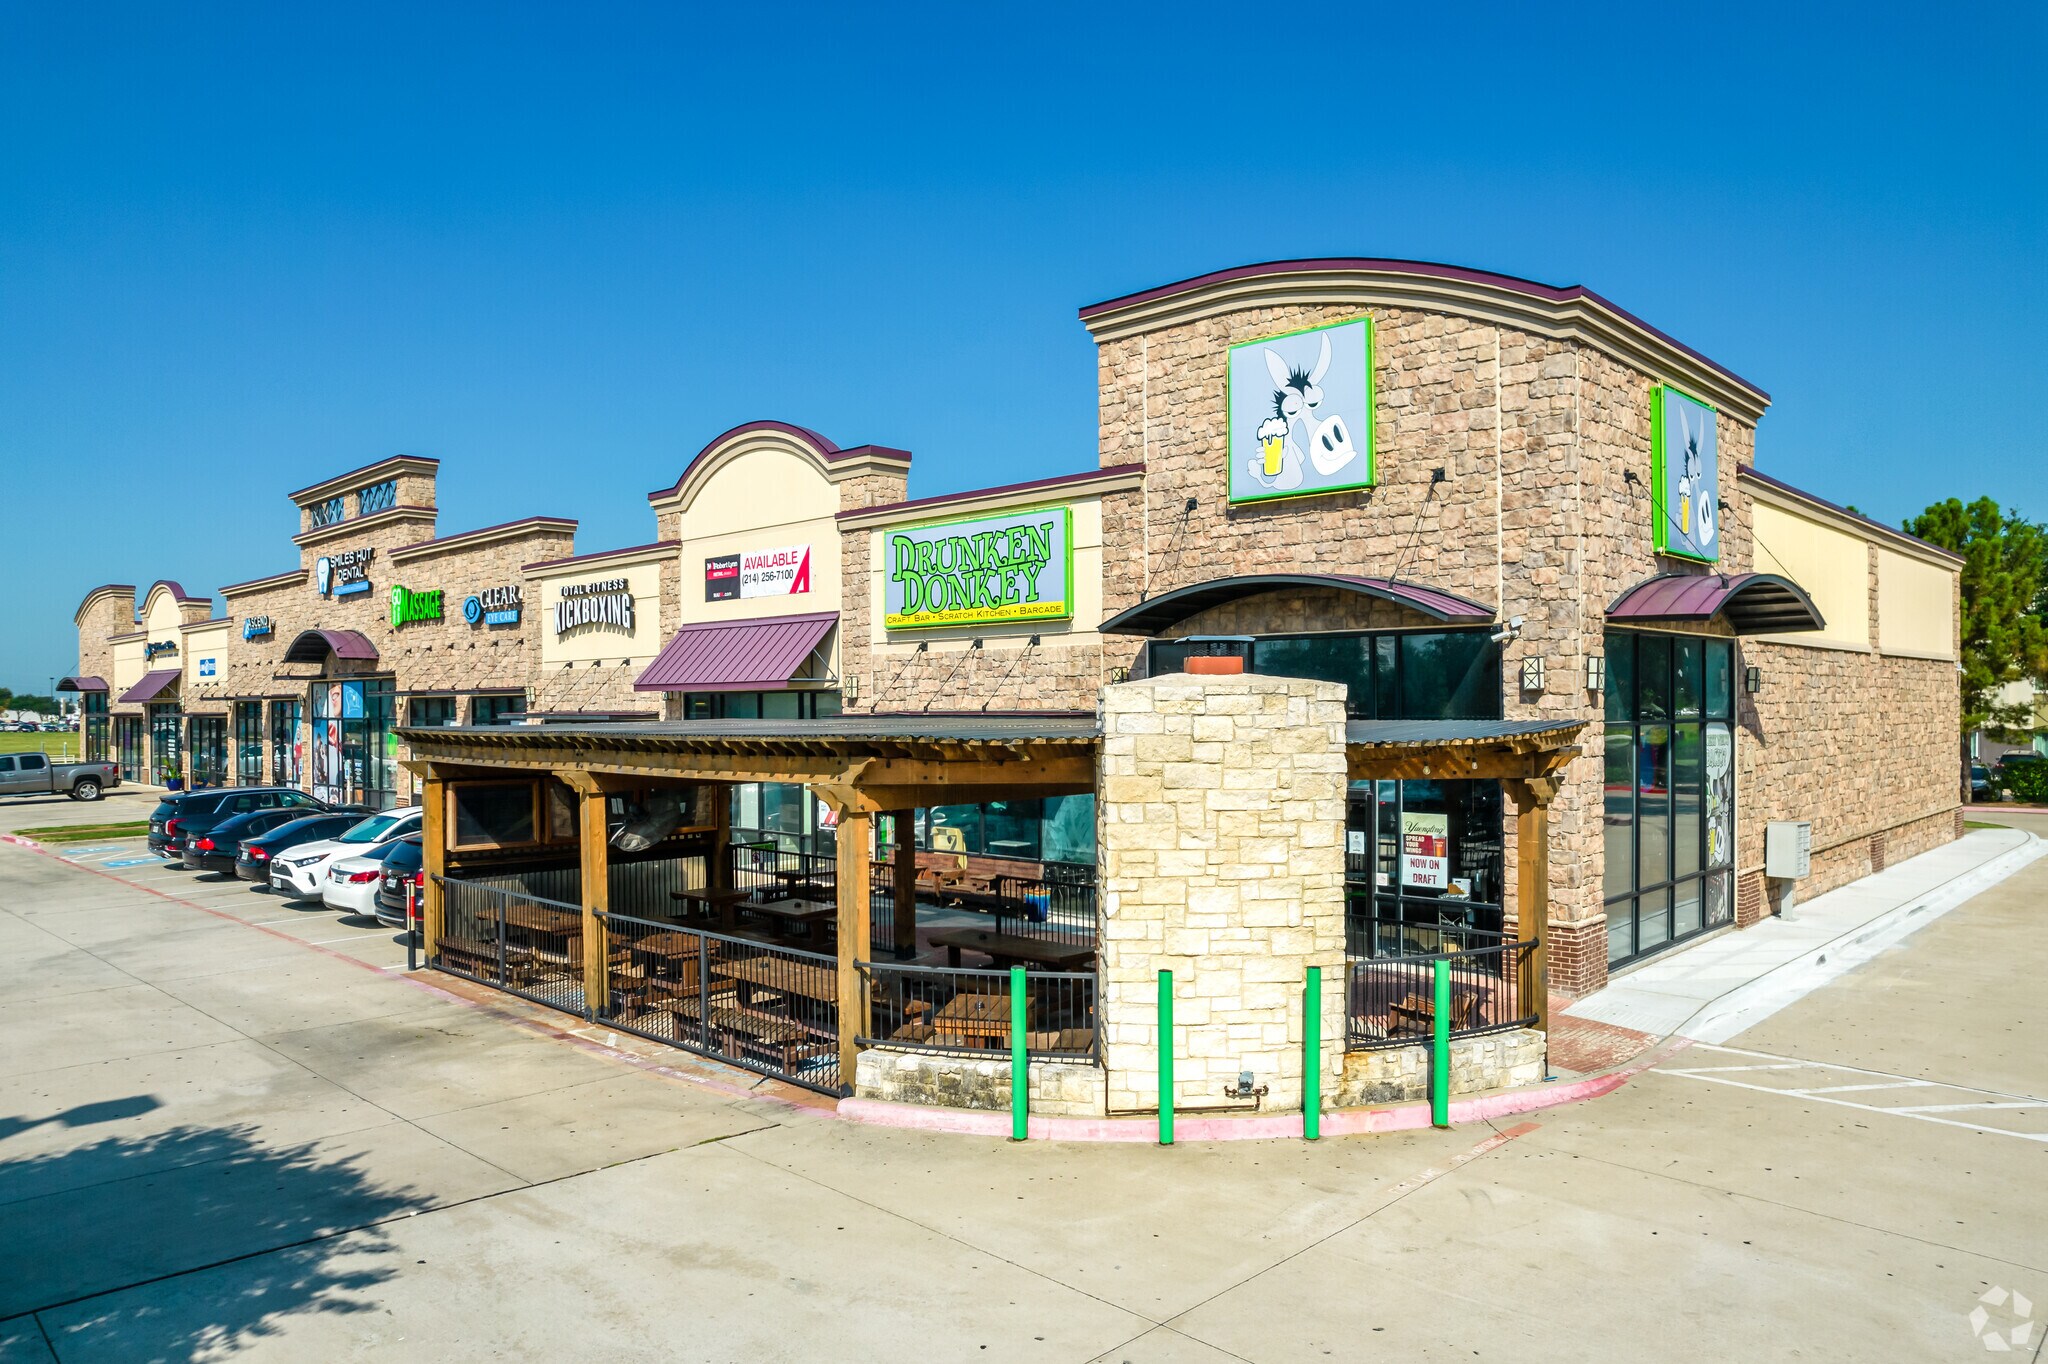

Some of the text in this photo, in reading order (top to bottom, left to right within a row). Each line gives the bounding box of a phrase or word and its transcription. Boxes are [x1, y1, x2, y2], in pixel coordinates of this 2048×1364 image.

[330, 547, 372, 568] SMILES HUT
[744, 551, 798, 570] AVAILABLE
[892, 521, 1054, 582] DRUNKEN
[338, 566, 364, 581] DENTAL
[742, 569, 794, 586] (214) 256-7100
[480, 585, 518, 608] CLEAR
[560, 578, 624, 596] TOTAL FITNESS
[901, 560, 1046, 616] DONKEY
[400, 589, 441, 621] MASSAGE
[554, 593, 631, 635] KICKBOXING
[887, 605, 1062, 624] CRAFT BAR SCRATCH KITCHEN BARCADE
[487, 611, 516, 623] EYE CARE
[1404, 820, 1446, 834] Yuengling
[1410, 857, 1440, 869] NOW ON
[1413, 873, 1437, 884] DRAFT
